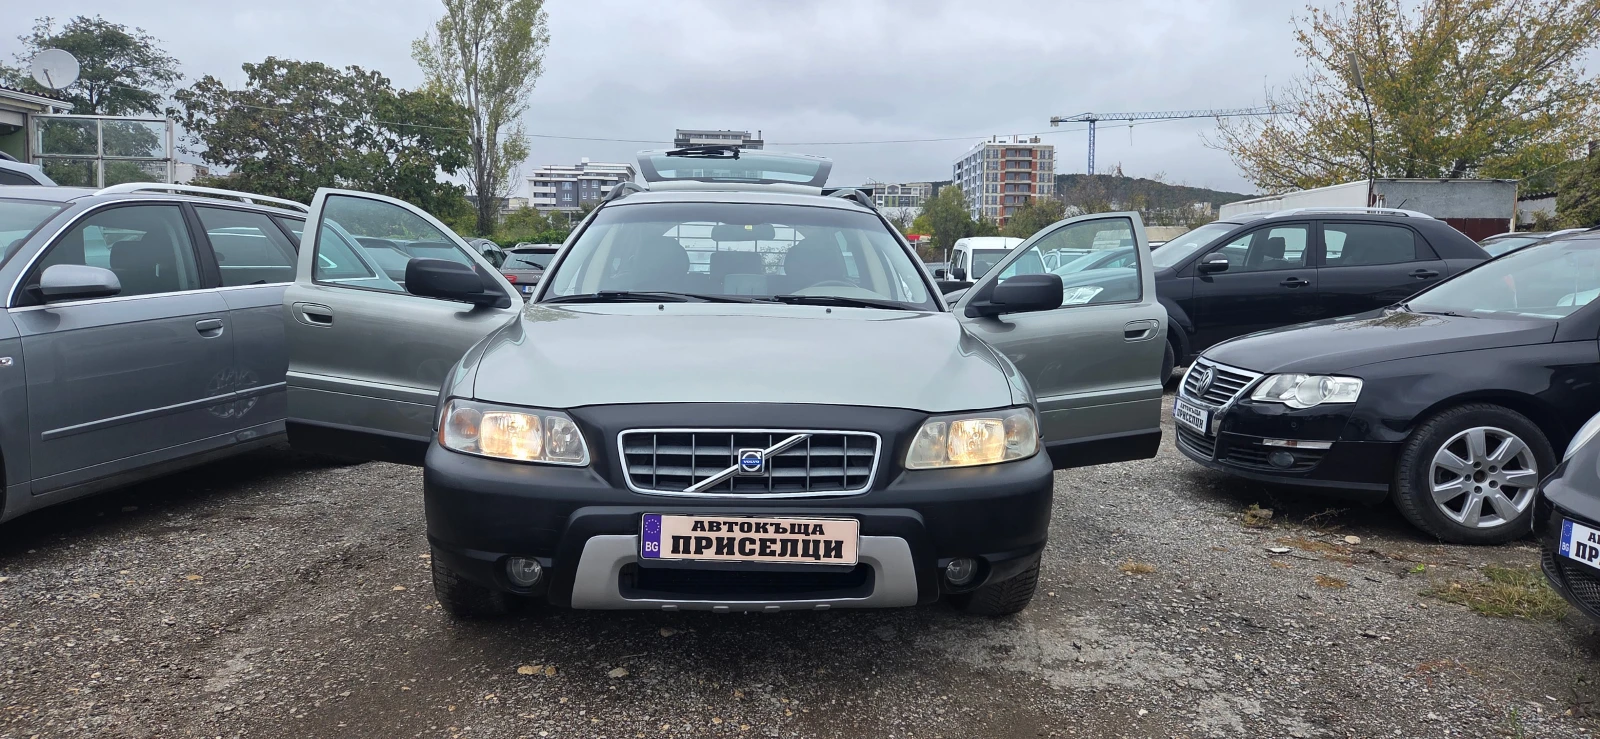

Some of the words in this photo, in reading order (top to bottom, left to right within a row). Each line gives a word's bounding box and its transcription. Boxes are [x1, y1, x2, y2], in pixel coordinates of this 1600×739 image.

[691, 520, 826, 537] АВТОКЪЩА
[1588, 532, 1600, 545] А
[645, 541, 659, 552] BG
[670, 535, 844, 560] ПРИСЕЛЦИ
[1561, 541, 1570, 552] BG
